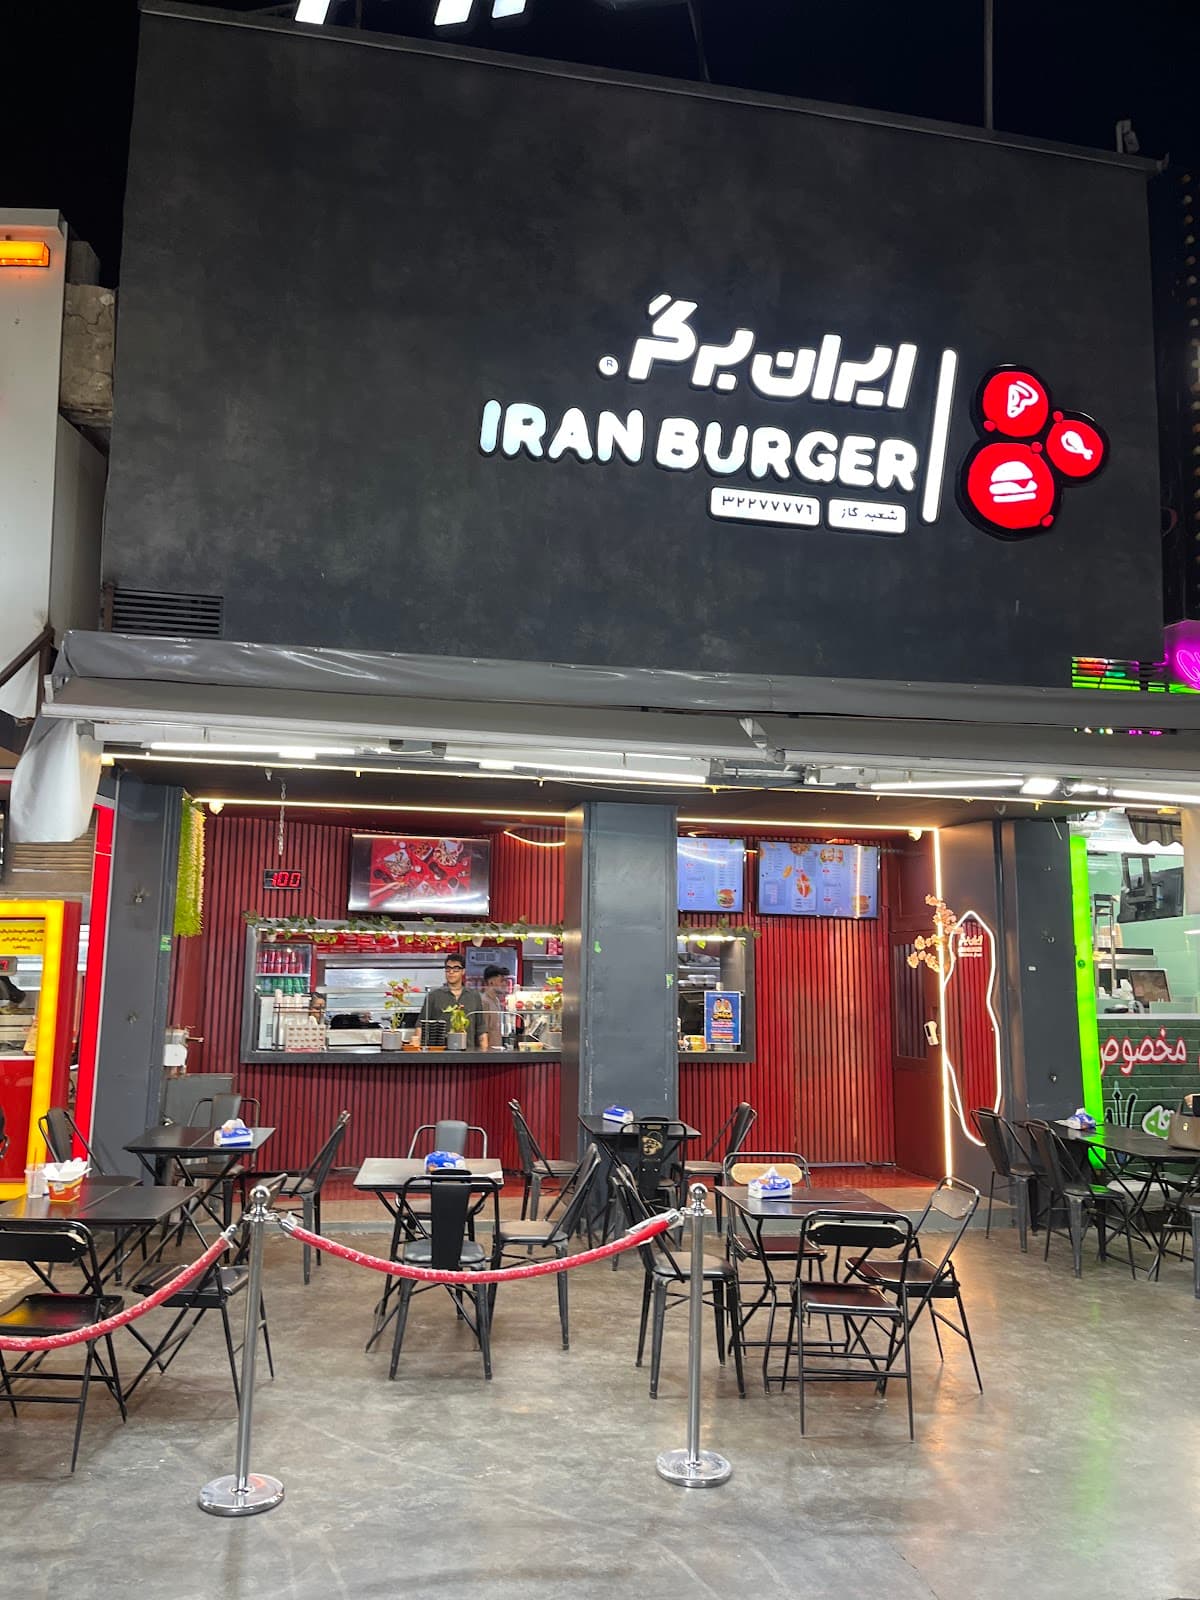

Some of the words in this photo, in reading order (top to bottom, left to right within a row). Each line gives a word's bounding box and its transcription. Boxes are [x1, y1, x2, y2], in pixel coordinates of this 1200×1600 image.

[627, 294, 754, 391] برگر
[751, 332, 918, 410] ایران
[480, 399, 644, 463] IRAN
[655, 416, 918, 492] BURGER
[863, 509, 899, 523] شعبه
